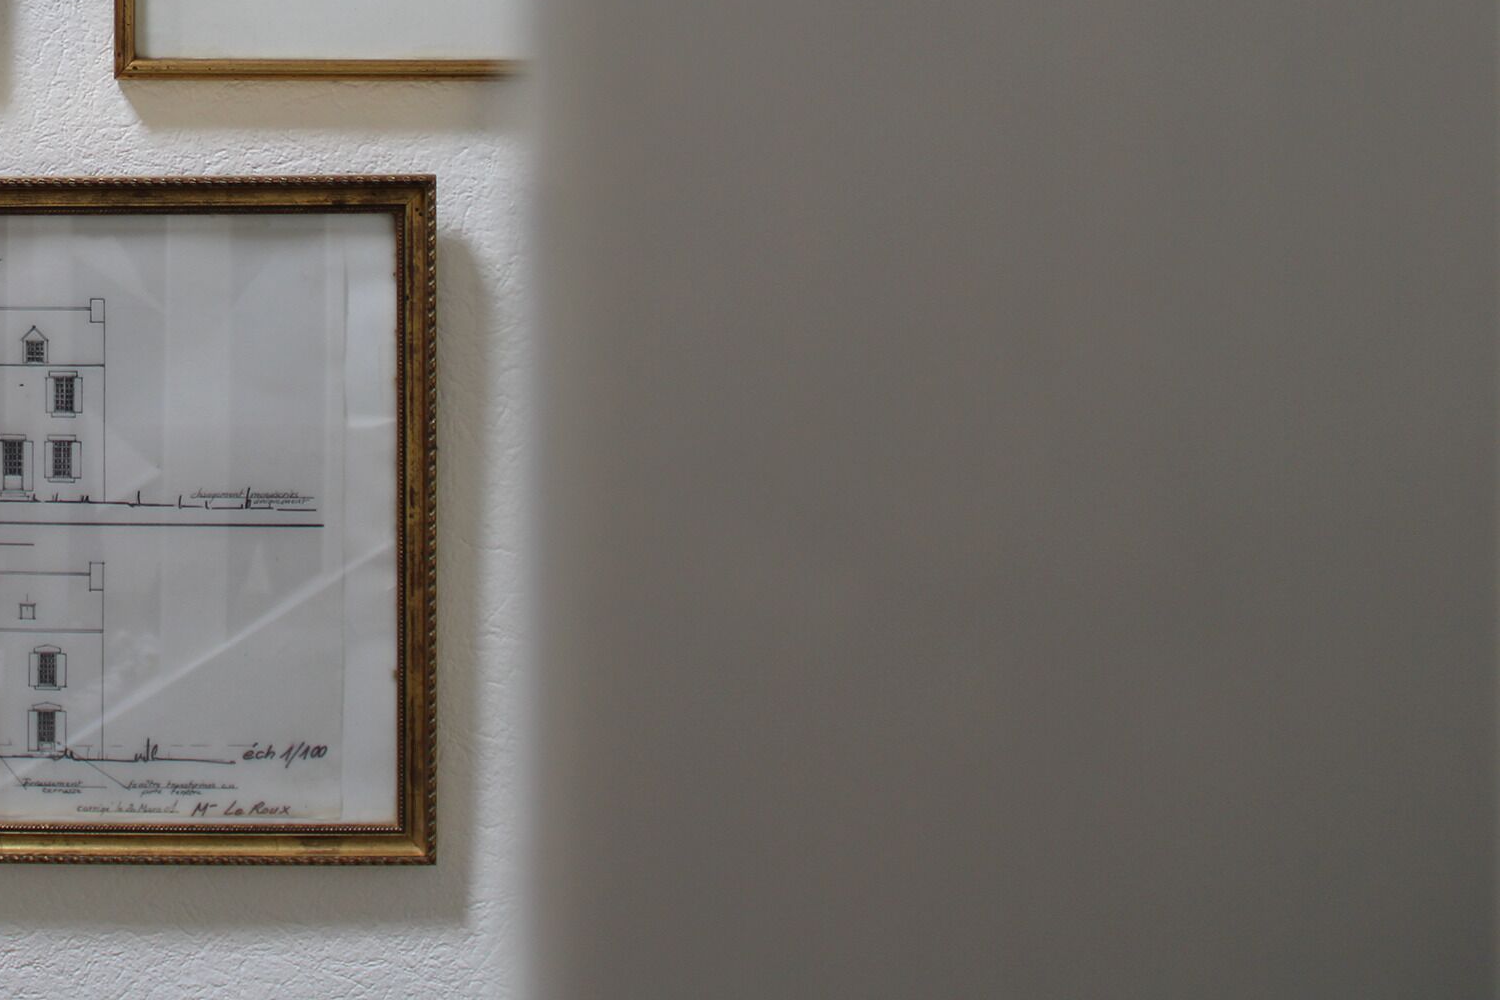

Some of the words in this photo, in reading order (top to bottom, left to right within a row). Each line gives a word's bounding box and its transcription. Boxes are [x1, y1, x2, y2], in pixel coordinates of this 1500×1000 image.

[242, 743, 276, 760] éch
[279, 742, 327, 769] 1/100
[250, 801, 291, 815] Roux
